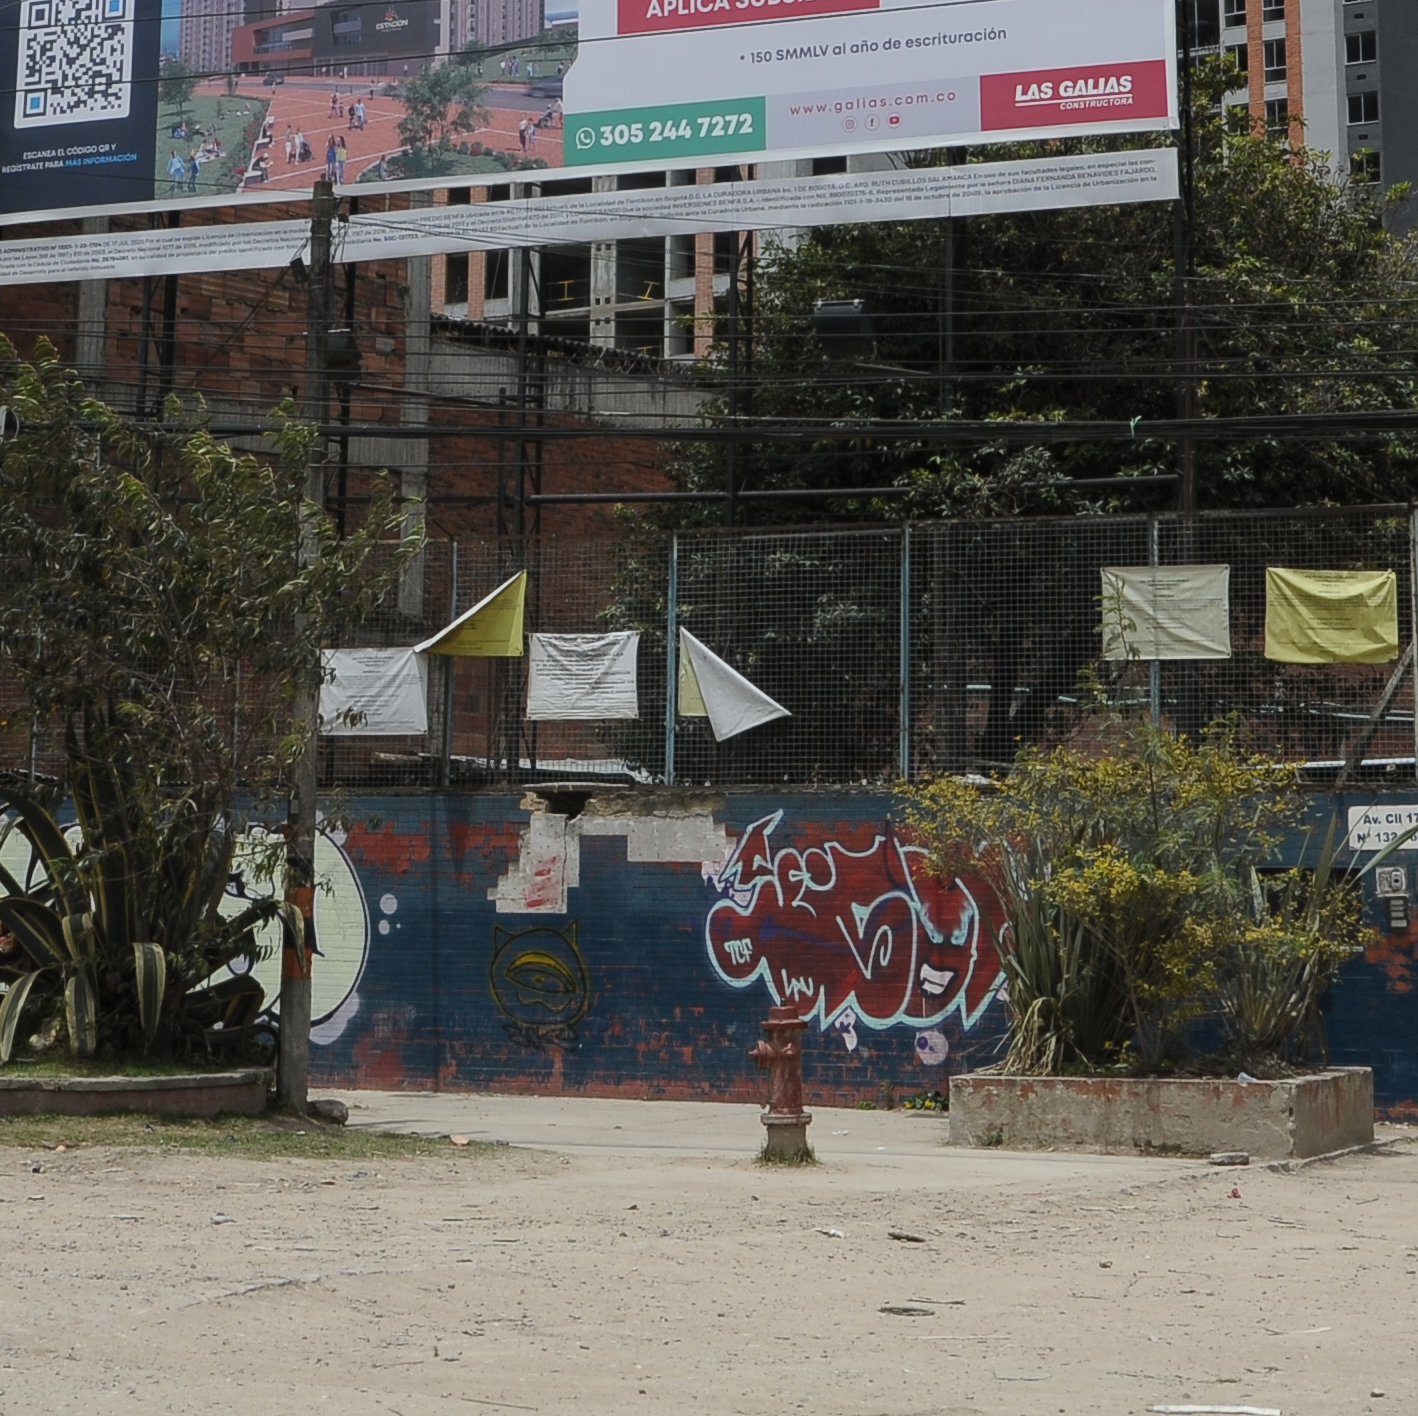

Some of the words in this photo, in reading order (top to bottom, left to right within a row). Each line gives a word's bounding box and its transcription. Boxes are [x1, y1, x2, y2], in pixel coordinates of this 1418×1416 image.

[750, 51, 772, 64] 150
[776, 44, 829, 62] SMMLV
[832, 42, 846, 56] al
[850, 39, 878, 54] año
[883, 37, 901, 51] de
[906, 28, 1007, 49] escrituración
[1015, 82, 1053, 101] LAS
[1059, 75, 1132, 97] GALIAS
[790, 90, 957, 115] www.galias.com.co
[1060, 97, 1133, 110] CONSTRUCTORA
[600, 124, 643, 146] 305
[649, 119, 692, 142] 244
[697, 113, 753, 137] 7272
[66, 145, 97, 156] CÓDIGO
[99, 144, 109, 152] QR
[45, 160, 64, 169] PARA
[65, 157, 81, 167] MÁS
[83, 153, 137, 164] INFORMACIÓN
[1363, 814, 1382, 825] Av.
[1385, 813, 1402, 824] Cll
